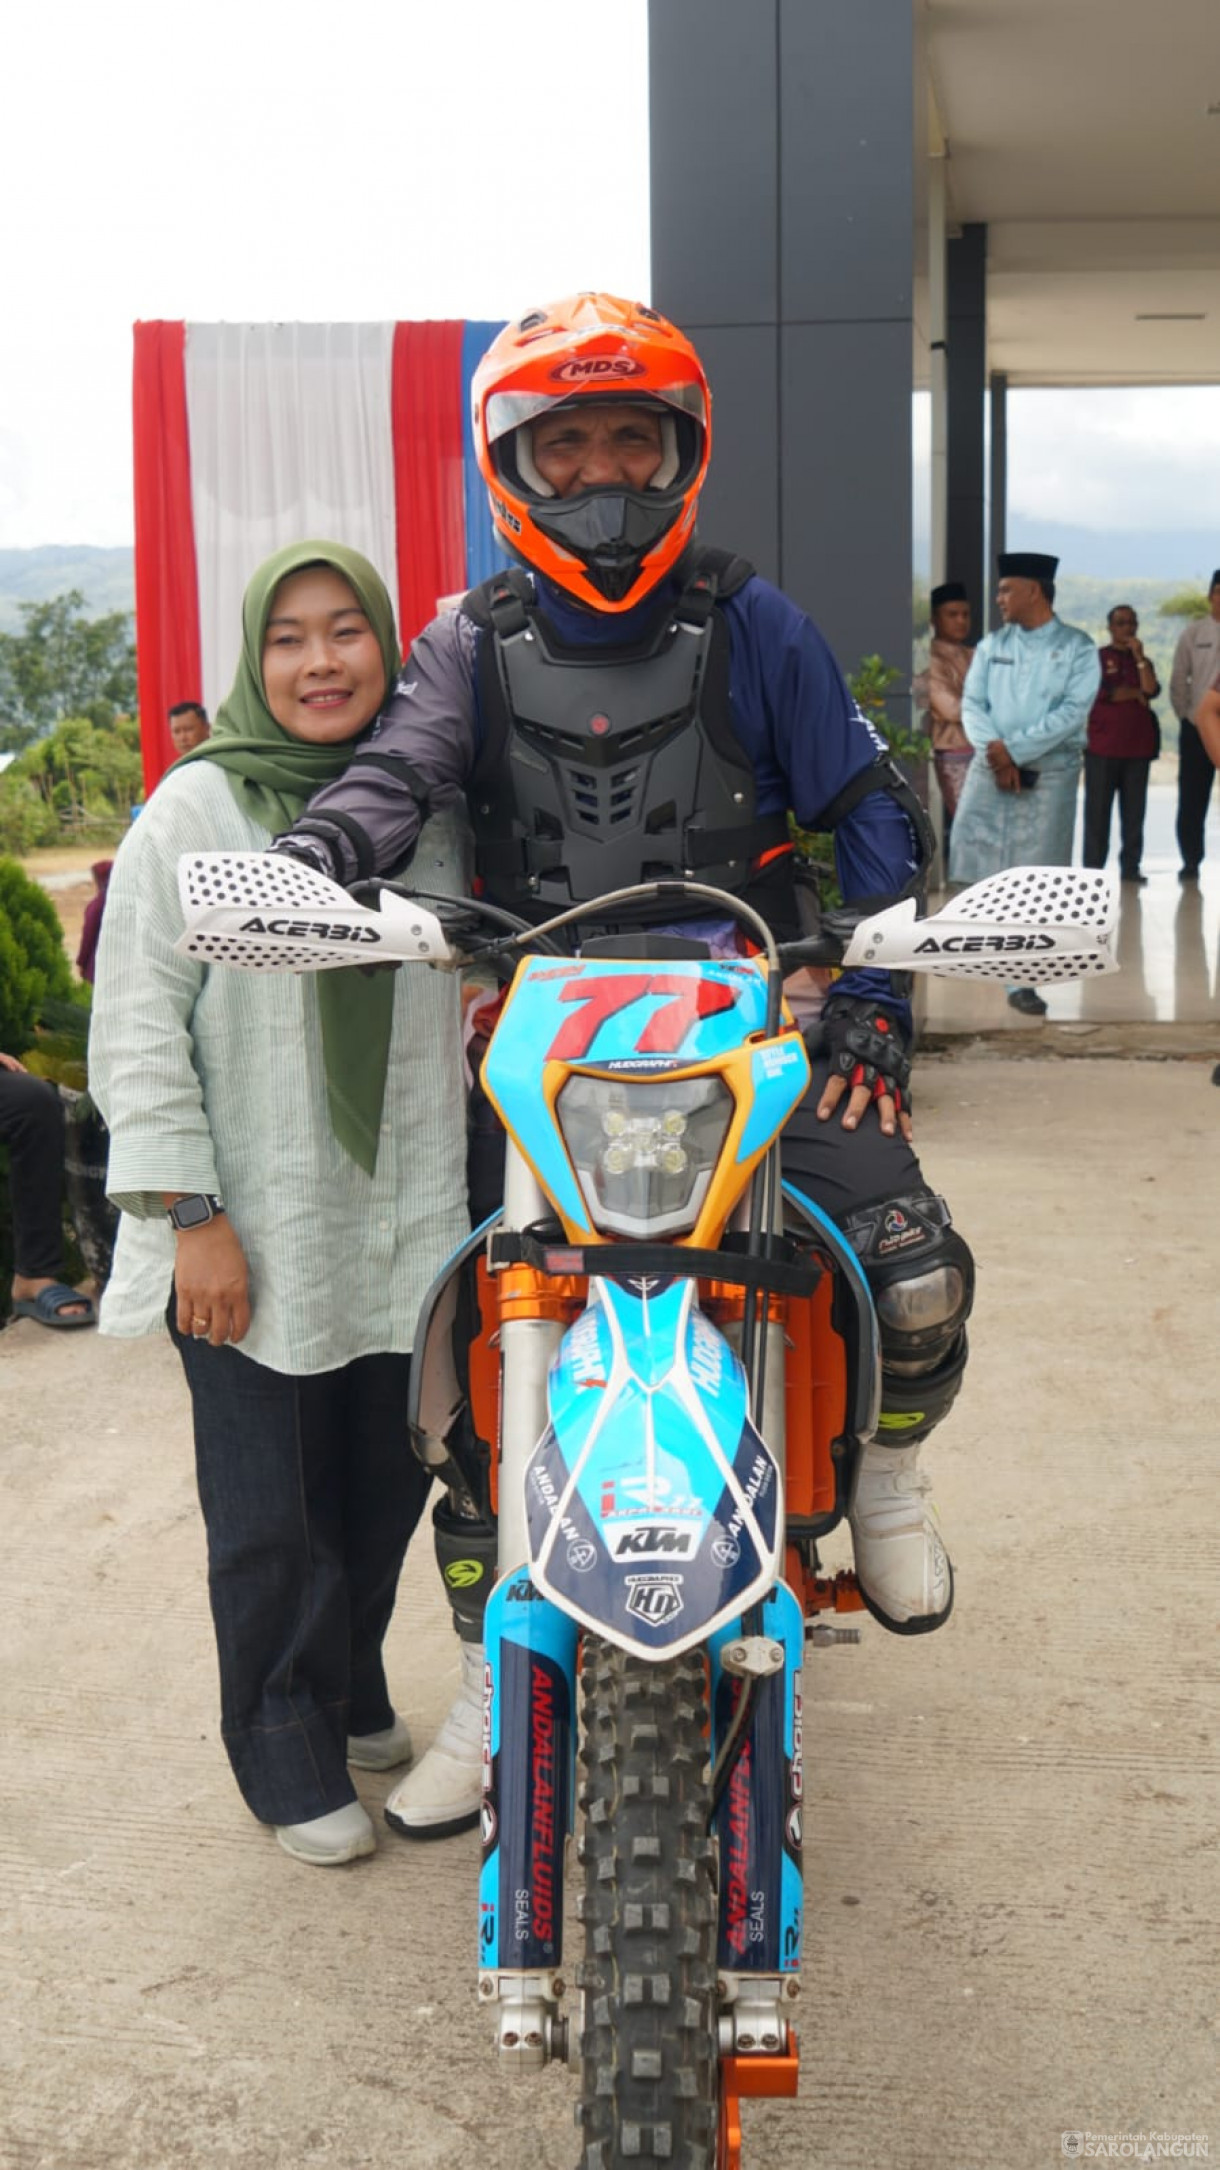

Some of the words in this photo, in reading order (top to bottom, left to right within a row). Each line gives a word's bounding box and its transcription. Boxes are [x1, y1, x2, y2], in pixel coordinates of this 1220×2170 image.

[570, 360, 631, 376] MDS
[615, 1526, 692, 1555] KTM
[515, 1889, 530, 1941] SEALS
[750, 1891, 765, 1942] SEALS
